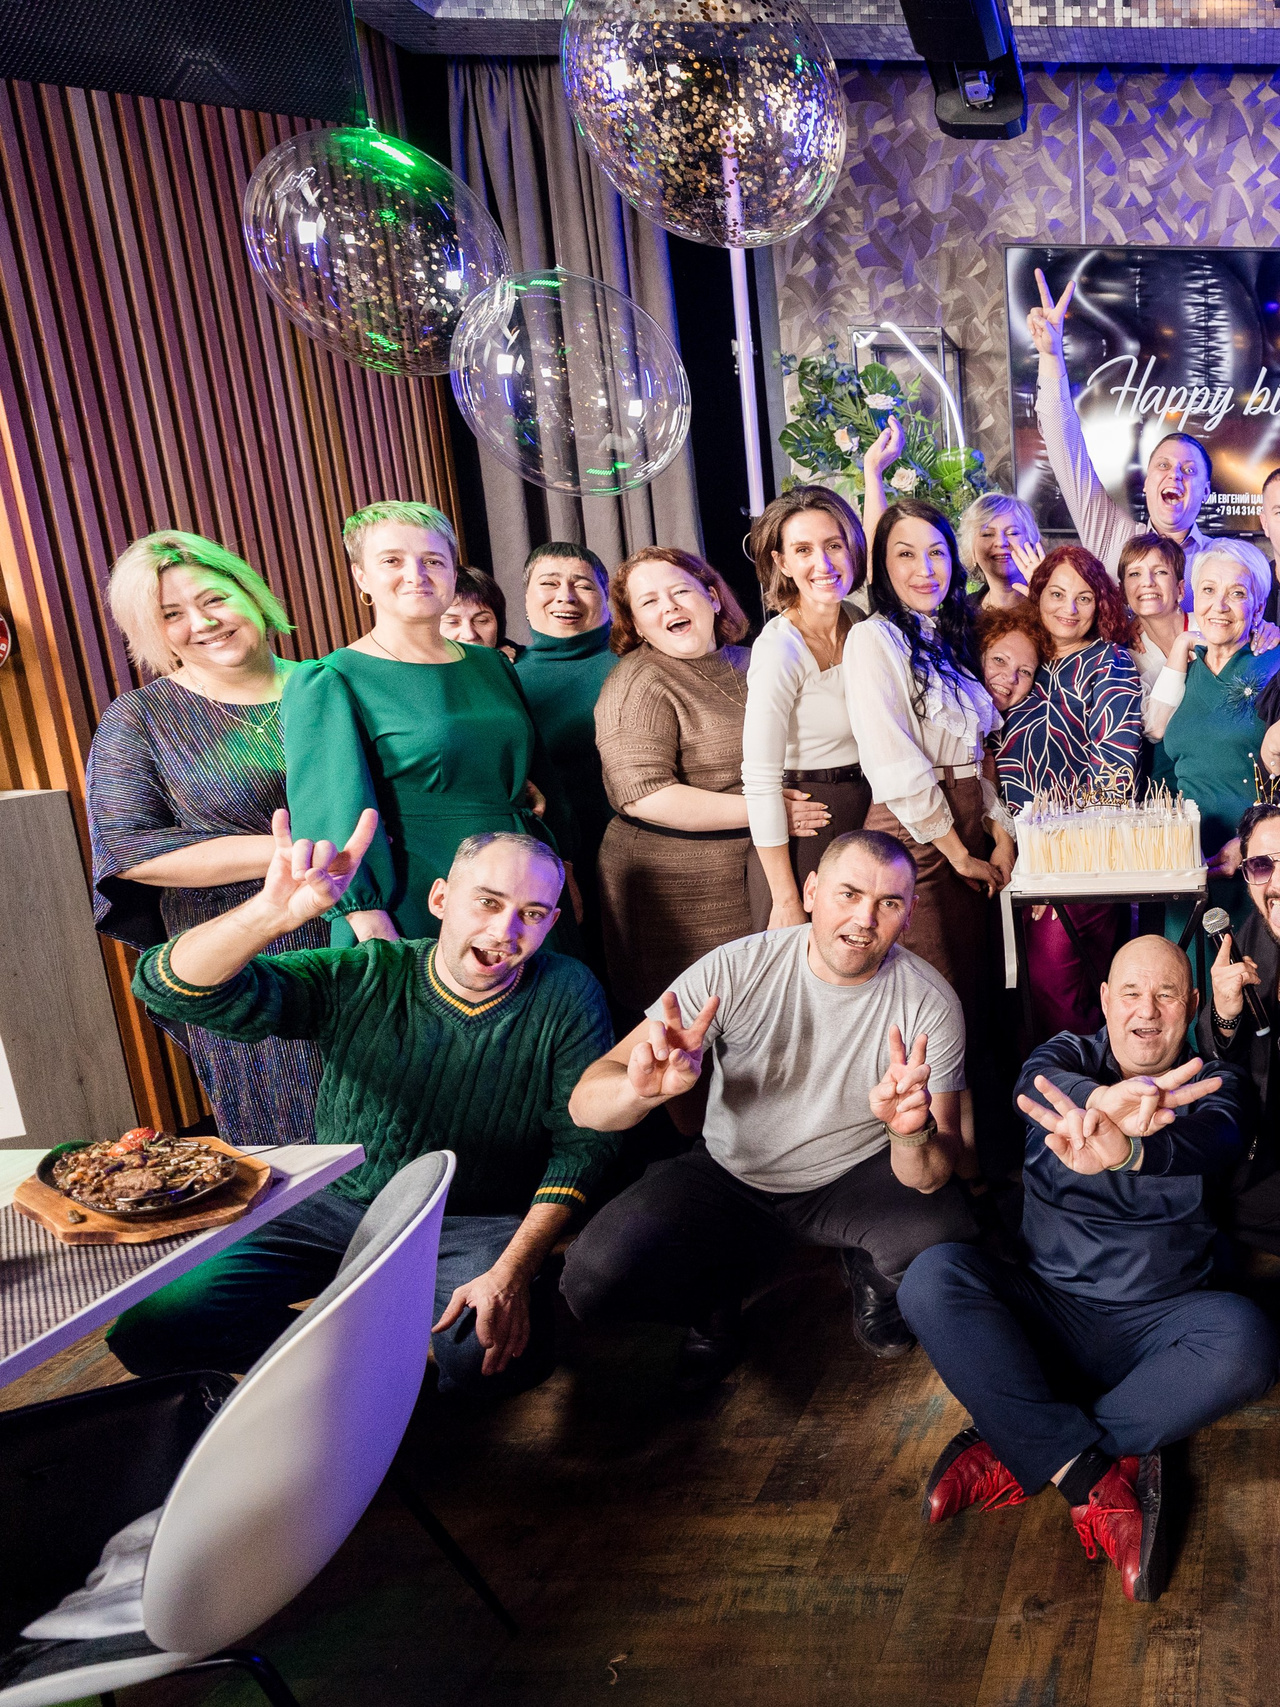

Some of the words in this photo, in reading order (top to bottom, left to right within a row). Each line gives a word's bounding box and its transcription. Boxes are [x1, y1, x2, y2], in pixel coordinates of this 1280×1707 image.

[1086, 354, 1235, 432] Happy
[1218, 492, 1250, 504] ЕВГЕНИЙ
[1215, 505, 1226, 516] +7
[1226, 505, 1241, 516] 914
[1241, 505, 1256, 516] 314
